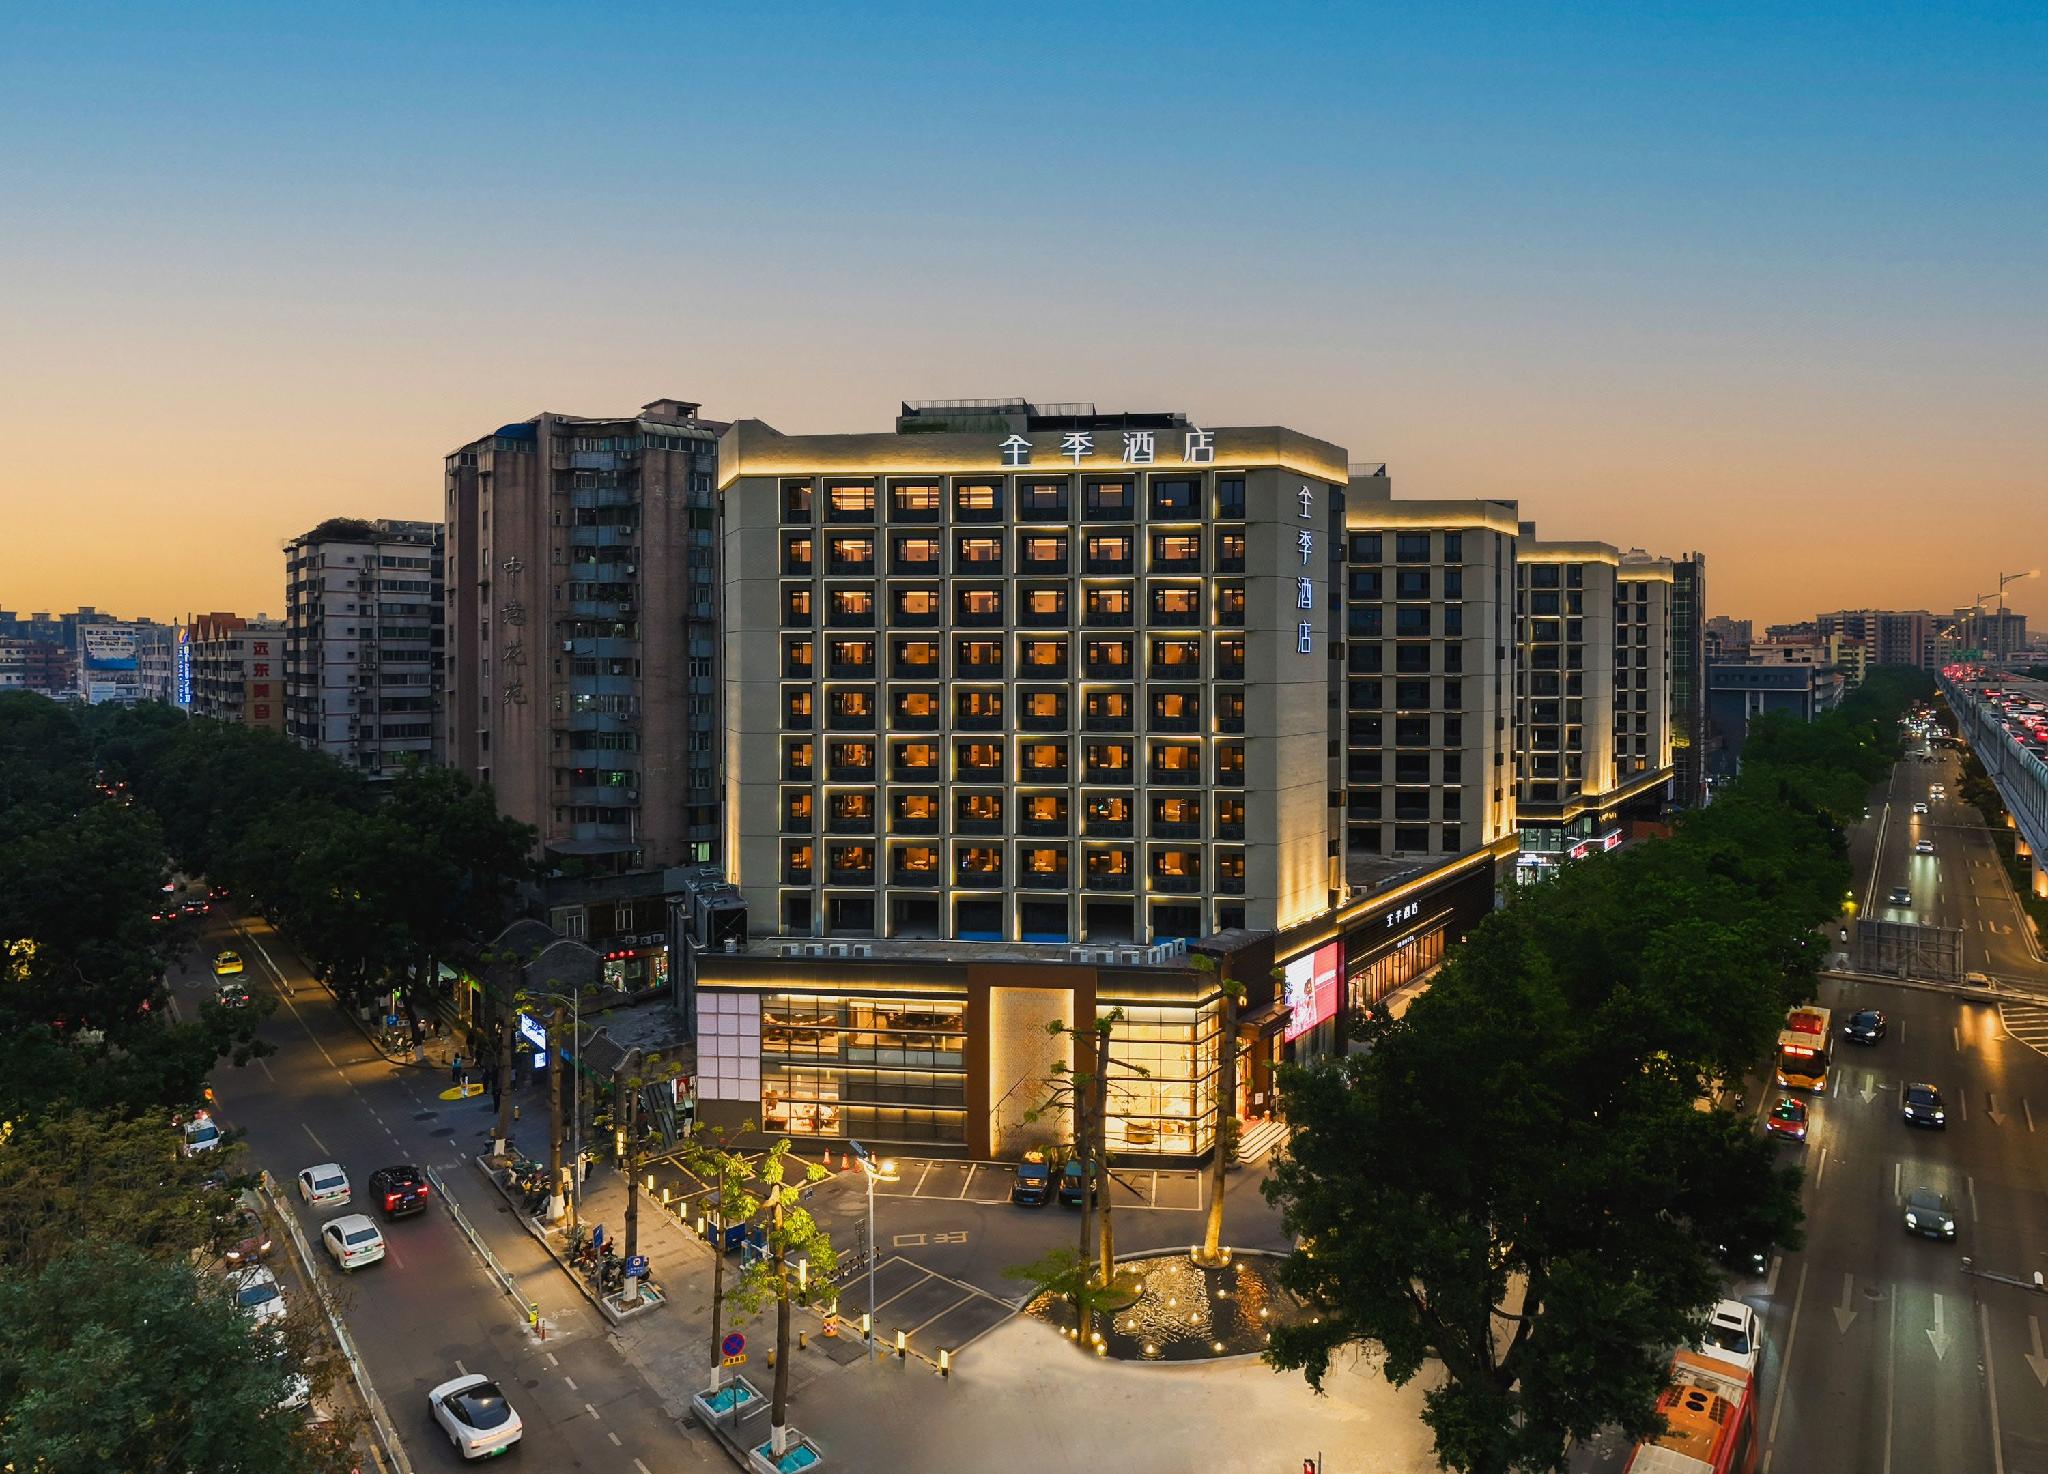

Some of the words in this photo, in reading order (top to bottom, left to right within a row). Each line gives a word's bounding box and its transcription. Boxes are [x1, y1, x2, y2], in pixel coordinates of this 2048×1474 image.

[998, 431, 1215, 467] 全季酒店
[1296, 485, 1314, 655] 全季酒店
[893, 1230, 969, 1248] 出口
